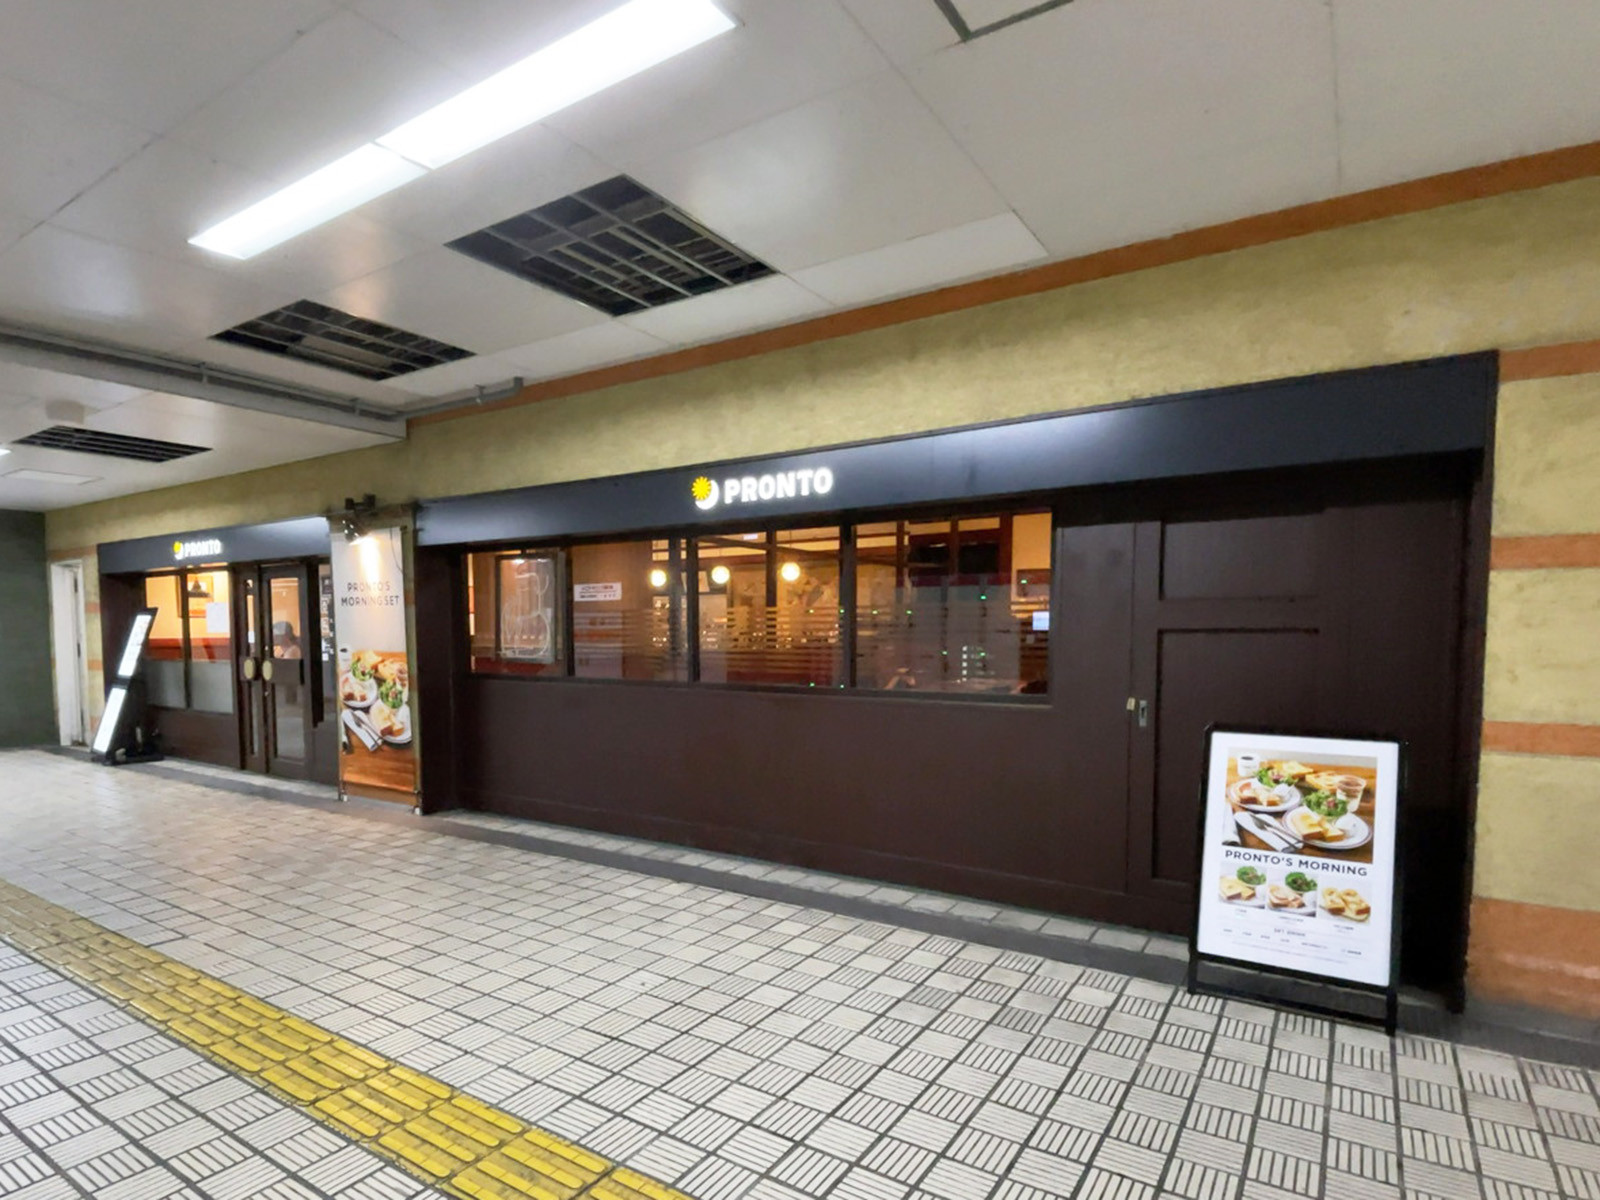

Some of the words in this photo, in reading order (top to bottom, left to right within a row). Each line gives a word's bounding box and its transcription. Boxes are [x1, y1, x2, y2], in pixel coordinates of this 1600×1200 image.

[723, 466, 834, 505] PRONTO
[184, 539, 222, 558] PRONTO
[341, 595, 383, 607] MORNING
[384, 595, 400, 606] SET
[1225, 850, 1293, 867] PRONTO'S
[1298, 860, 1368, 877] MORNING
